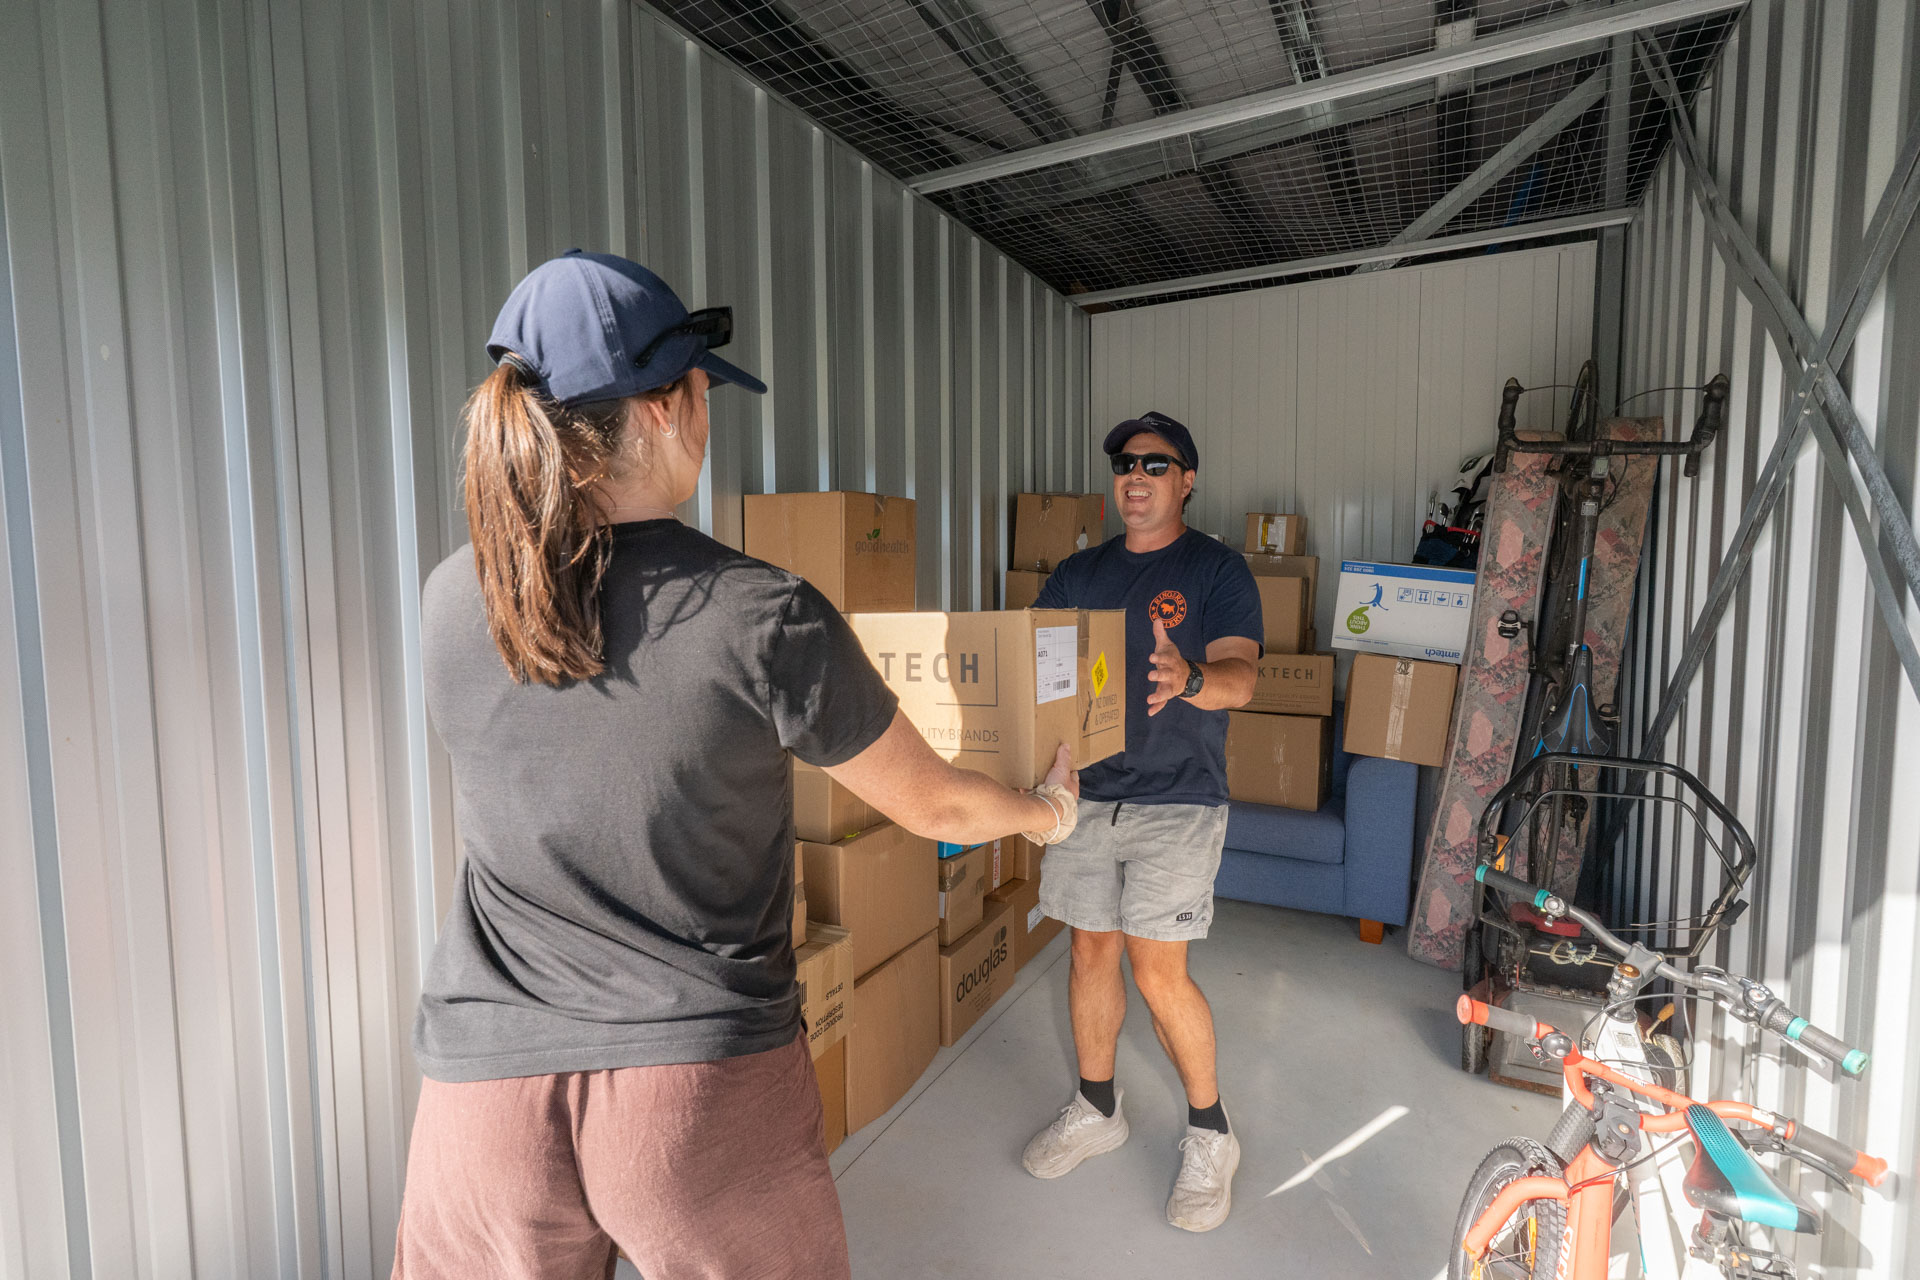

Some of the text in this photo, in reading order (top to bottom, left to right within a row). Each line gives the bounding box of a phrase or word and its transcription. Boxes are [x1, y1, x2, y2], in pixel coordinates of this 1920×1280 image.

[1425, 648, 1460, 658] amtech
[879, 652, 979, 684] TECH
[1258, 666, 1313, 680] KTECH
[921, 727, 999, 743] LITY BRANDS
[956, 942, 1007, 1003] douglas
[825, 982, 844, 1000] DETAILS
[810, 1027, 823, 1043] CODE
